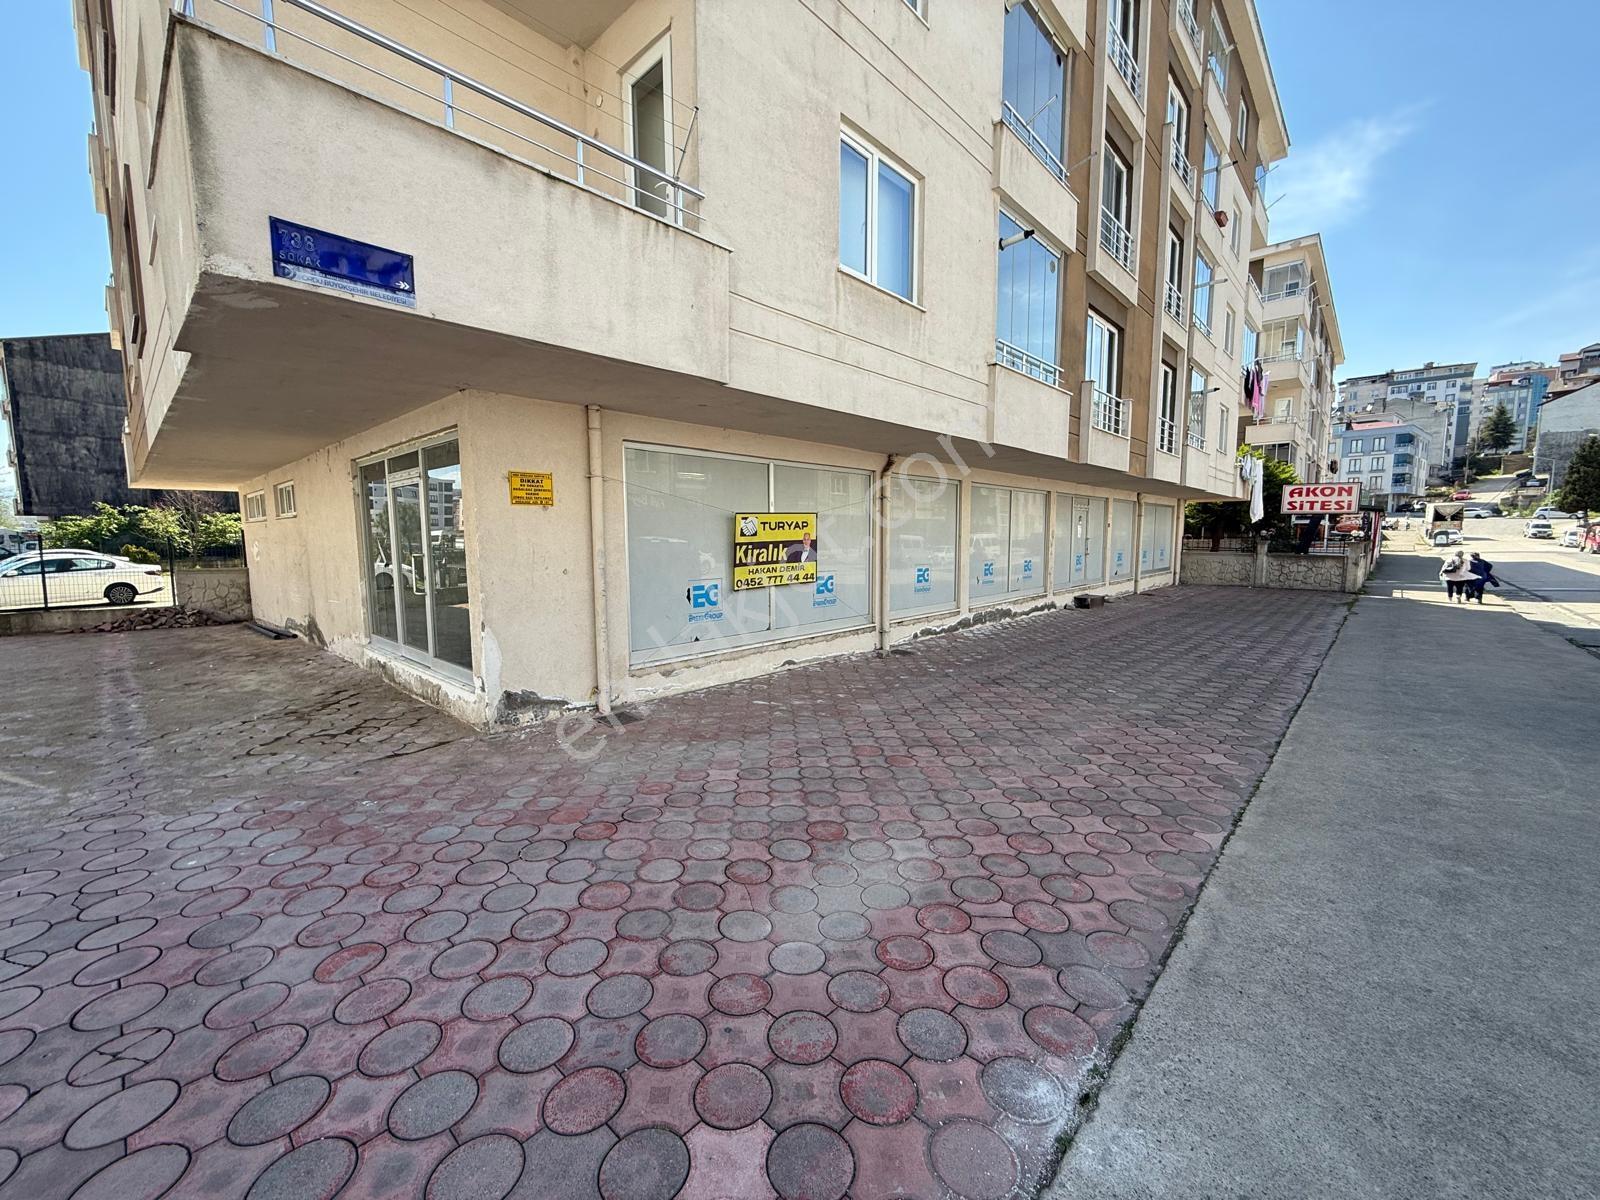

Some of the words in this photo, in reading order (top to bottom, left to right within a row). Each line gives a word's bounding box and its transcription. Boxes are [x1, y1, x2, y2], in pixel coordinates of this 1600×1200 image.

[279, 250, 321, 268] SOKAK
[302, 274, 321, 285] ORDU
[1288, 486, 1353, 498] AKON
[760, 521, 809, 531] TURYAP
[735, 543, 789, 564] Kiralık
[748, 566, 778, 575] HAKAN
[916, 567, 930, 583] EG
[735, 576, 764, 588] 0452
[766, 574, 784, 584] 777
[786, 573, 800, 582] 44
[802, 572, 815, 581] 44
[815, 575, 834, 595] EG
[692, 584, 719, 608] EG
